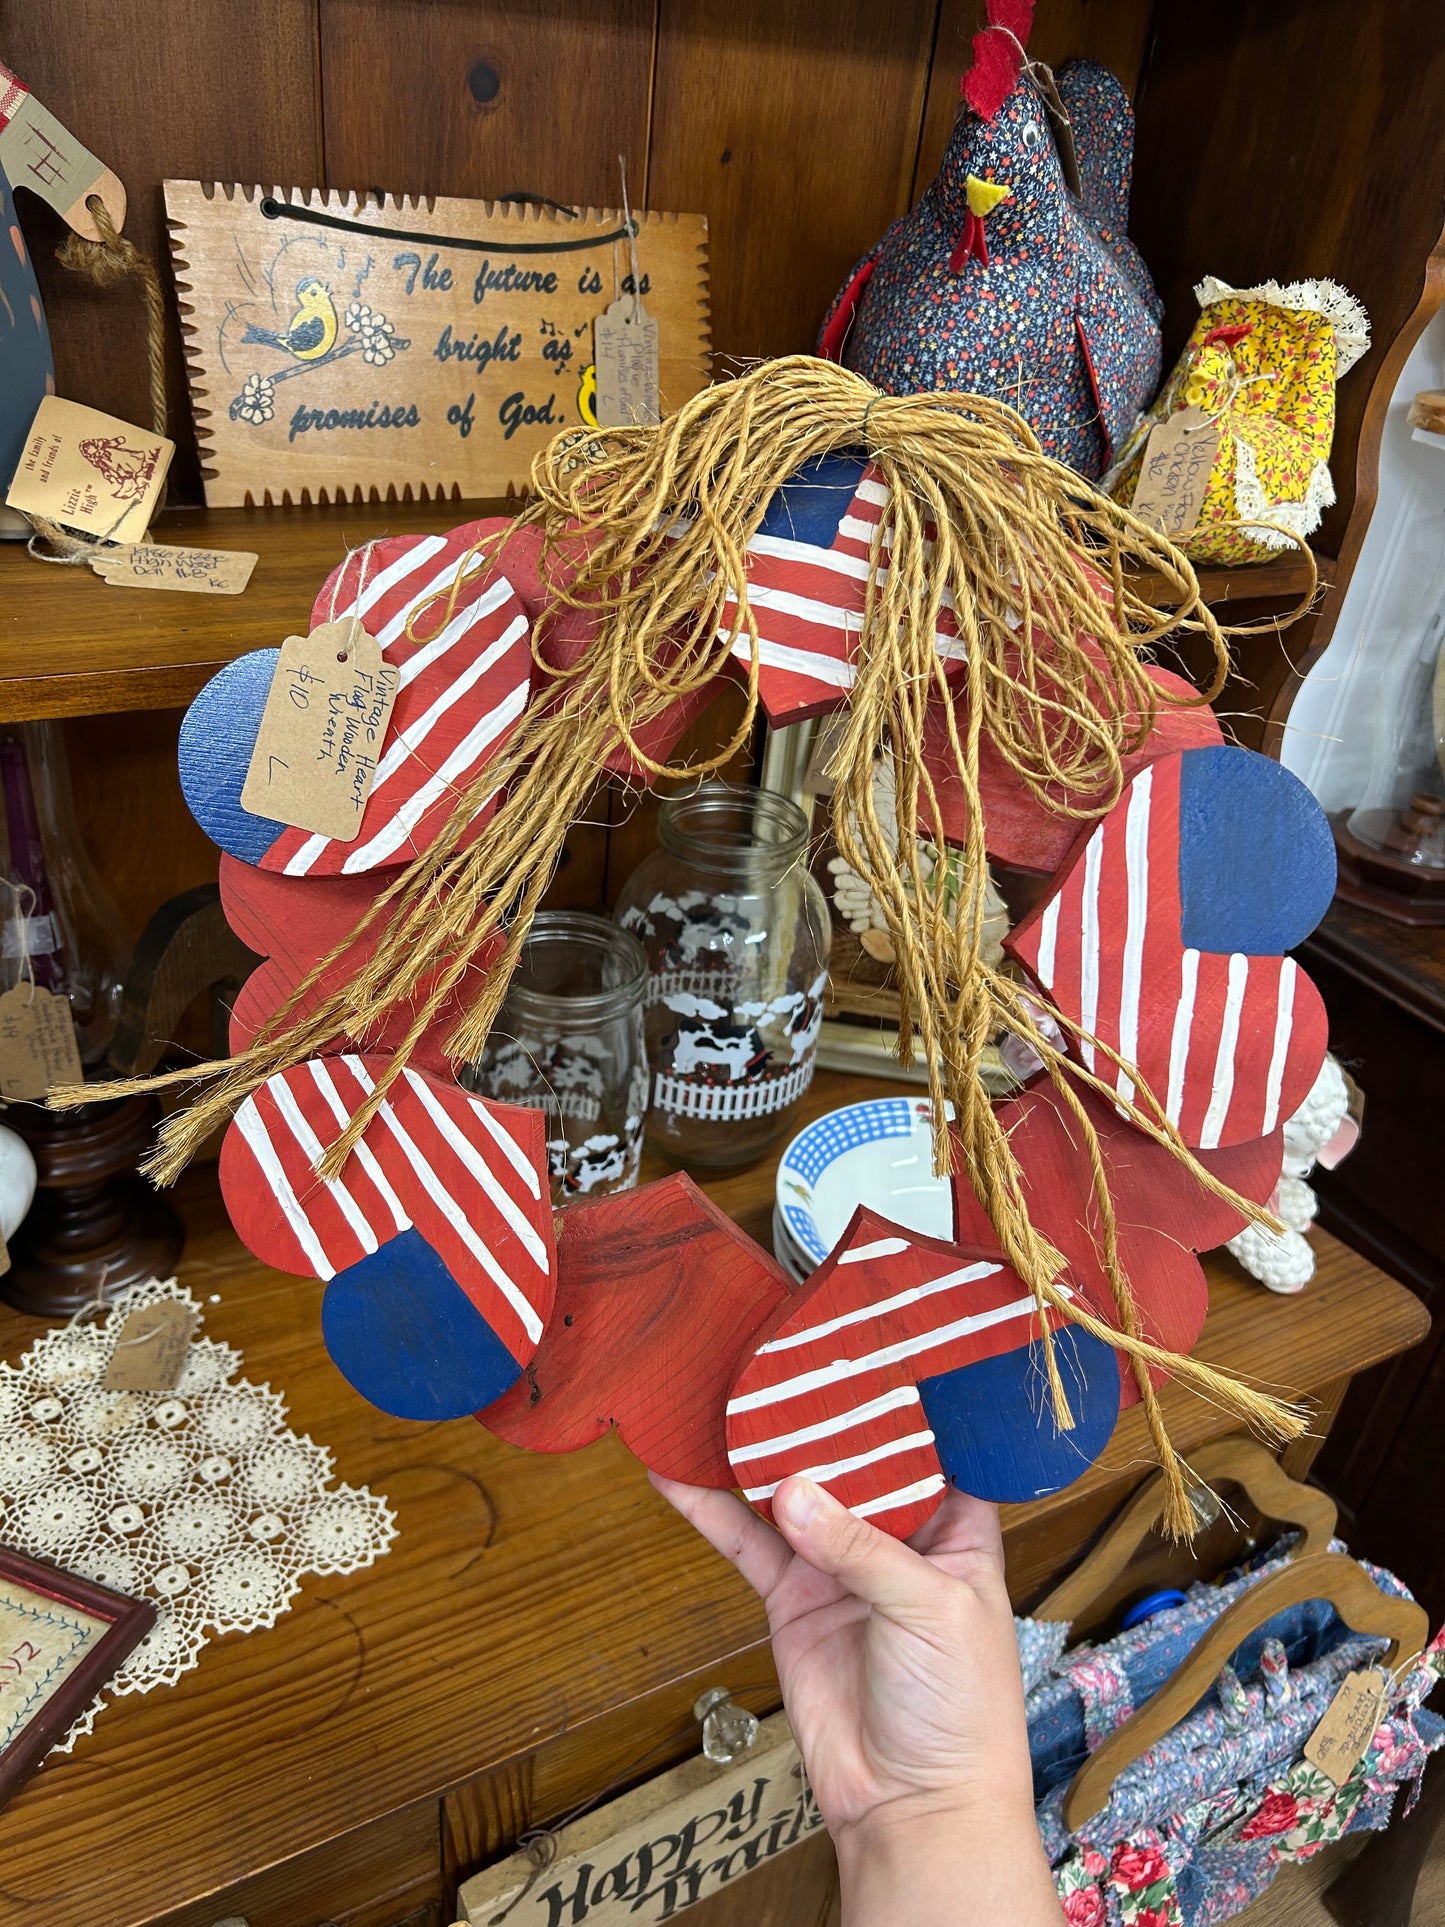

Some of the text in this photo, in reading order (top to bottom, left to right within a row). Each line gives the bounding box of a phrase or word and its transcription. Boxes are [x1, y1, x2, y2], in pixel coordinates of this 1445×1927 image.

[393, 253, 652, 304] The future is as
[434, 324, 574, 374] bright as
[289, 391, 566, 442] promises of God.
[25, 436, 47, 471] the family
[40, 434, 63, 483] and friends of
[1182, 434, 1218, 490] Yellow
[61, 489, 81, 516] Lizzie
[286, 664, 326, 710] $10
[316, 693, 344, 761] Wreath
[335, 669, 375, 776] Flag Wooden
[350, 669, 397, 812] Vintage Heart
[536, 1777, 771, 1927] Happy
